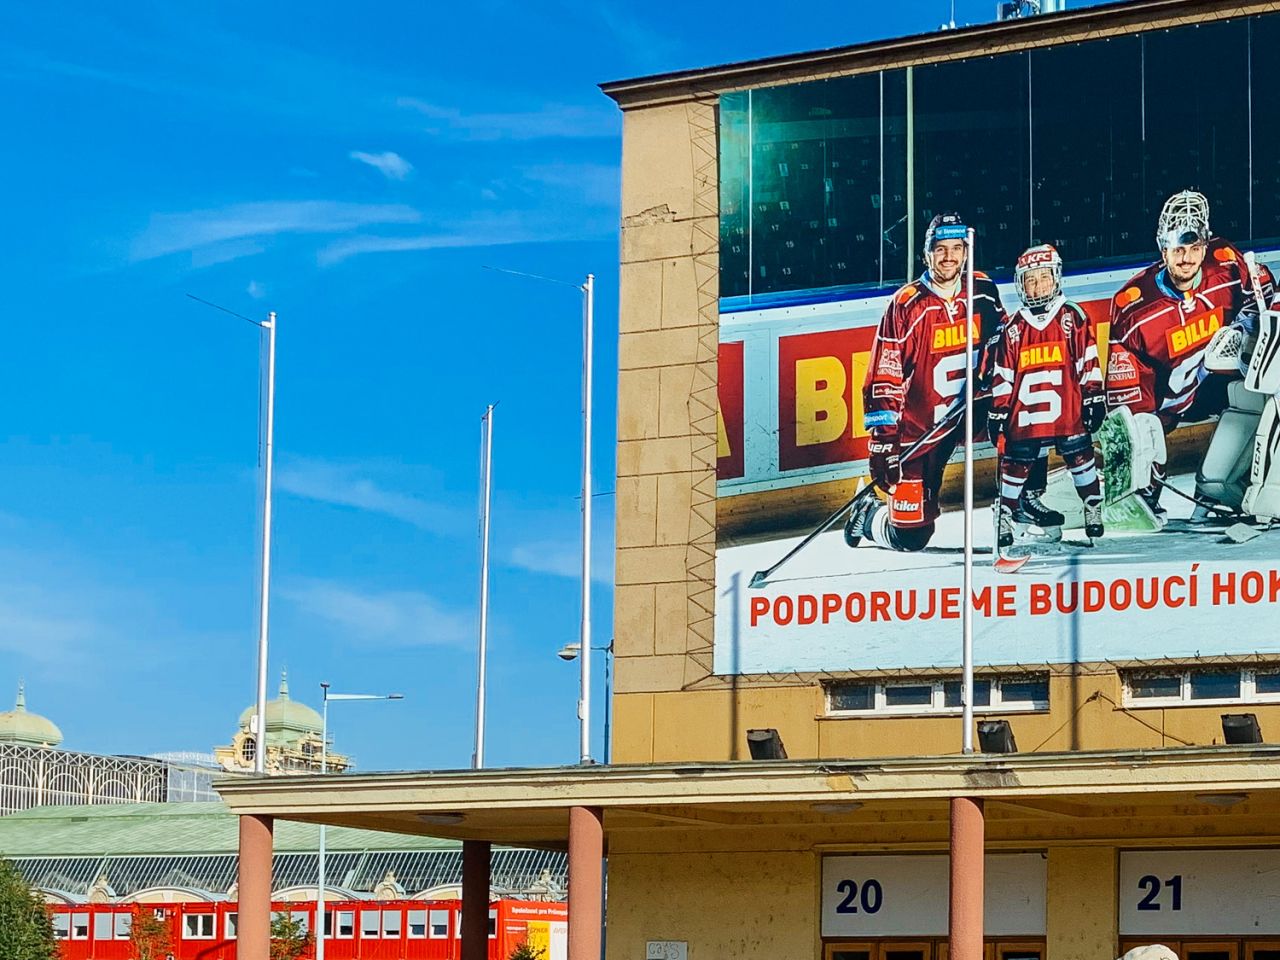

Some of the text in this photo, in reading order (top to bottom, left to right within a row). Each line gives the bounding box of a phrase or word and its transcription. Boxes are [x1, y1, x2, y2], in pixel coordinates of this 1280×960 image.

[1027, 251, 1052, 264] KFC
[933, 320, 980, 349] BILLA
[1170, 314, 1222, 353] BILLA
[1020, 345, 1062, 368] BILLA
[1253, 332, 1269, 372] CCM
[1018, 369, 1063, 427] S
[1253, 440, 1262, 478] CCM
[893, 498, 920, 512] kika
[750, 584, 1017, 627] PODPORUJEME
[1030, 563, 1200, 616] BUDOUCÍ
[836, 878, 883, 914] 20
[1137, 875, 1182, 911] 21
